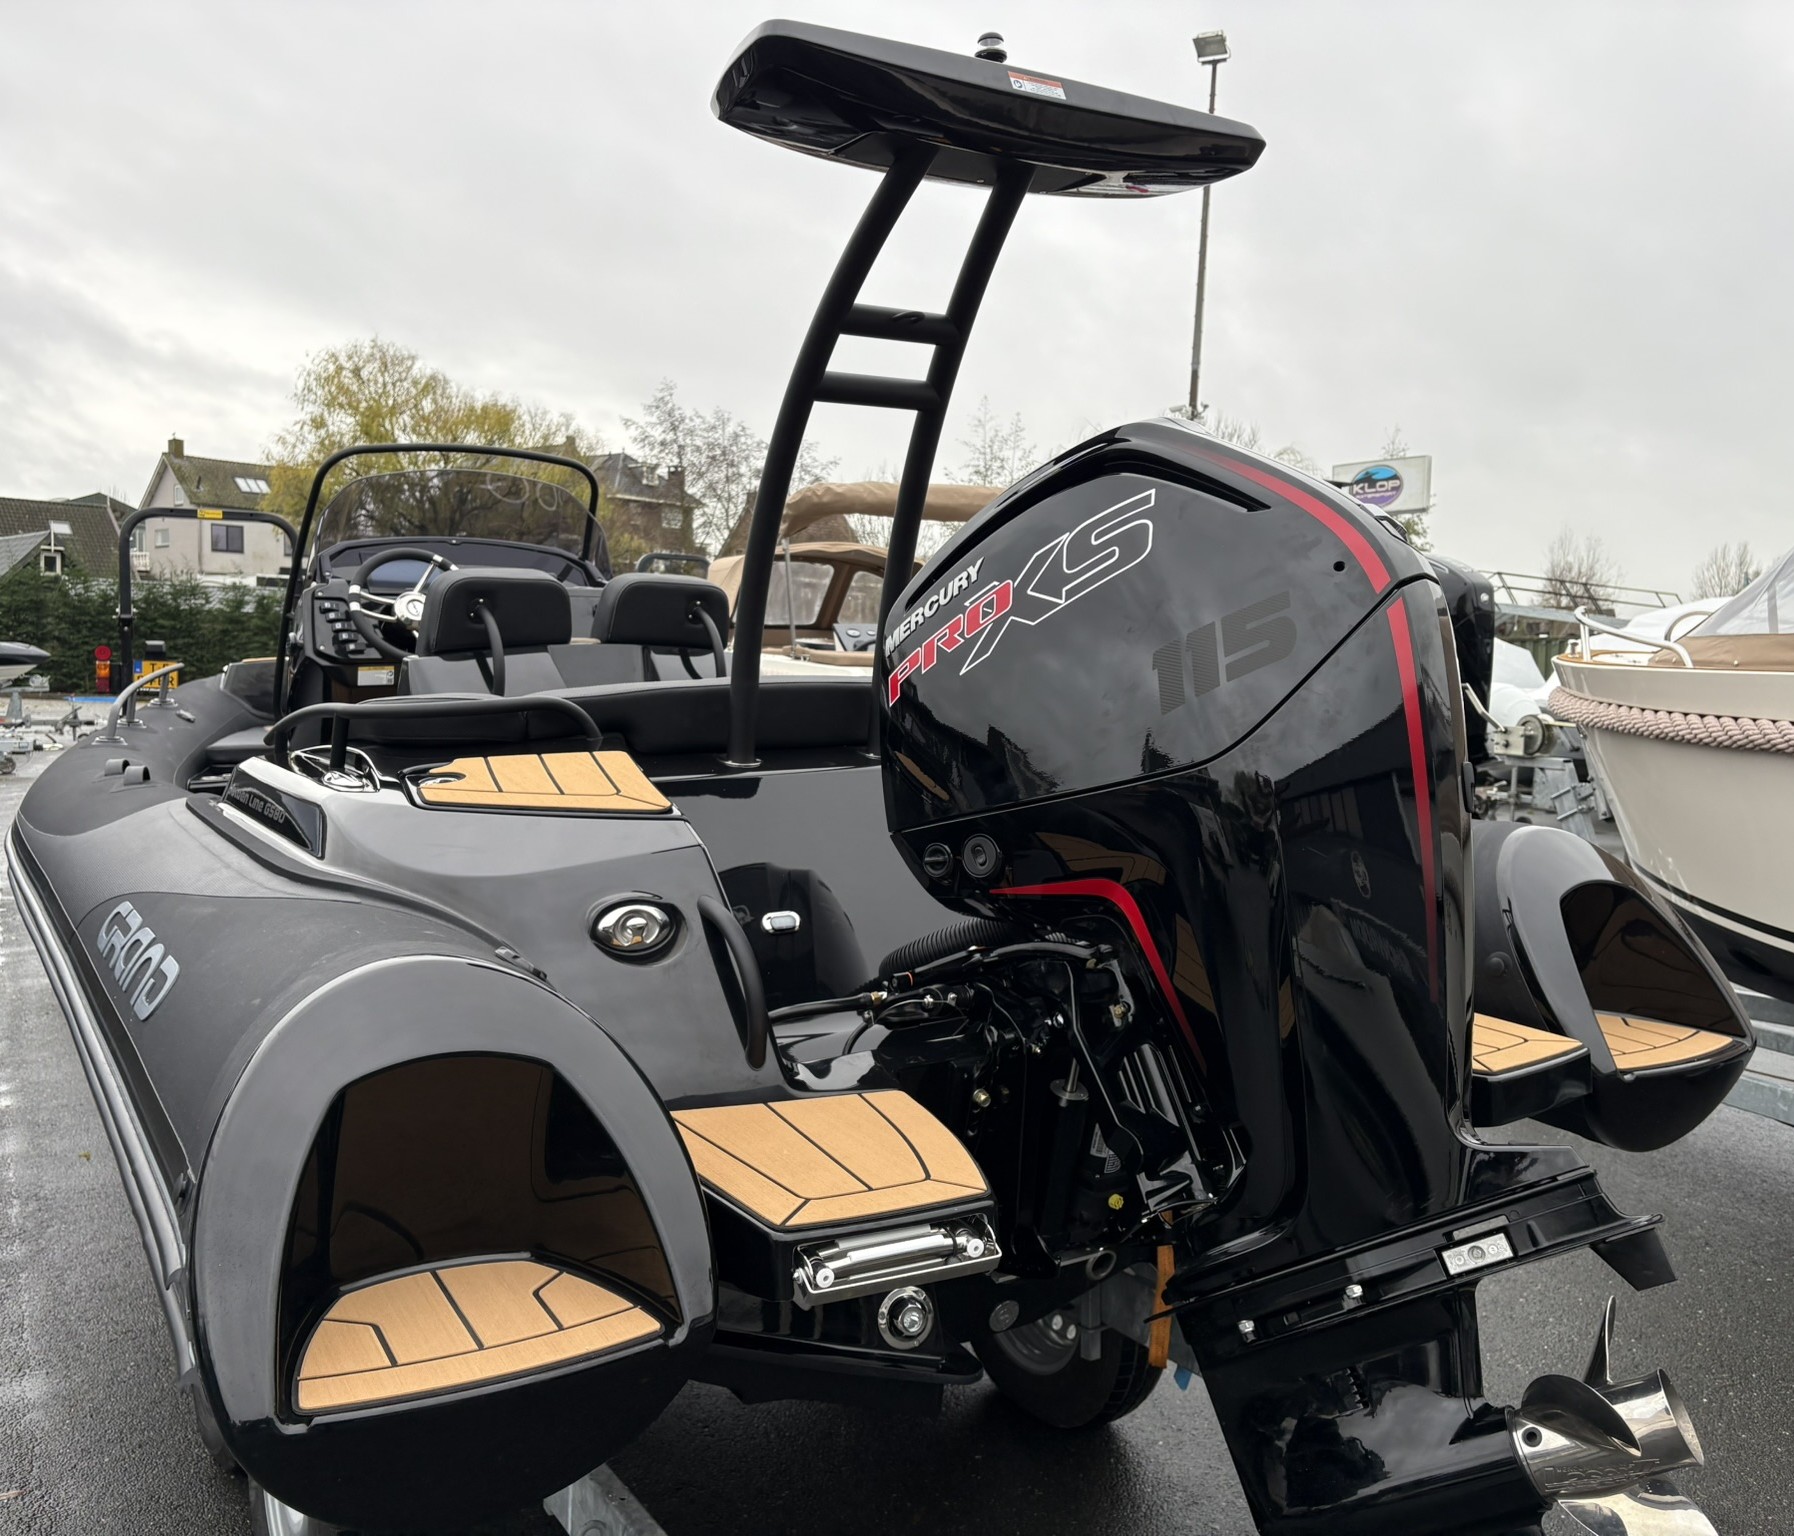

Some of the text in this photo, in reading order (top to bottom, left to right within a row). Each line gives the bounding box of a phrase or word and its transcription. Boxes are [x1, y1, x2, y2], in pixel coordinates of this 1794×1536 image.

[1352, 479, 1401, 495] KLOP
[886, 556, 985, 657] MERCURY
[888, 488, 1156, 707] PRO XS
[1151, 590, 1298, 716] 115
[97, 900, 180, 1021] GRAND
